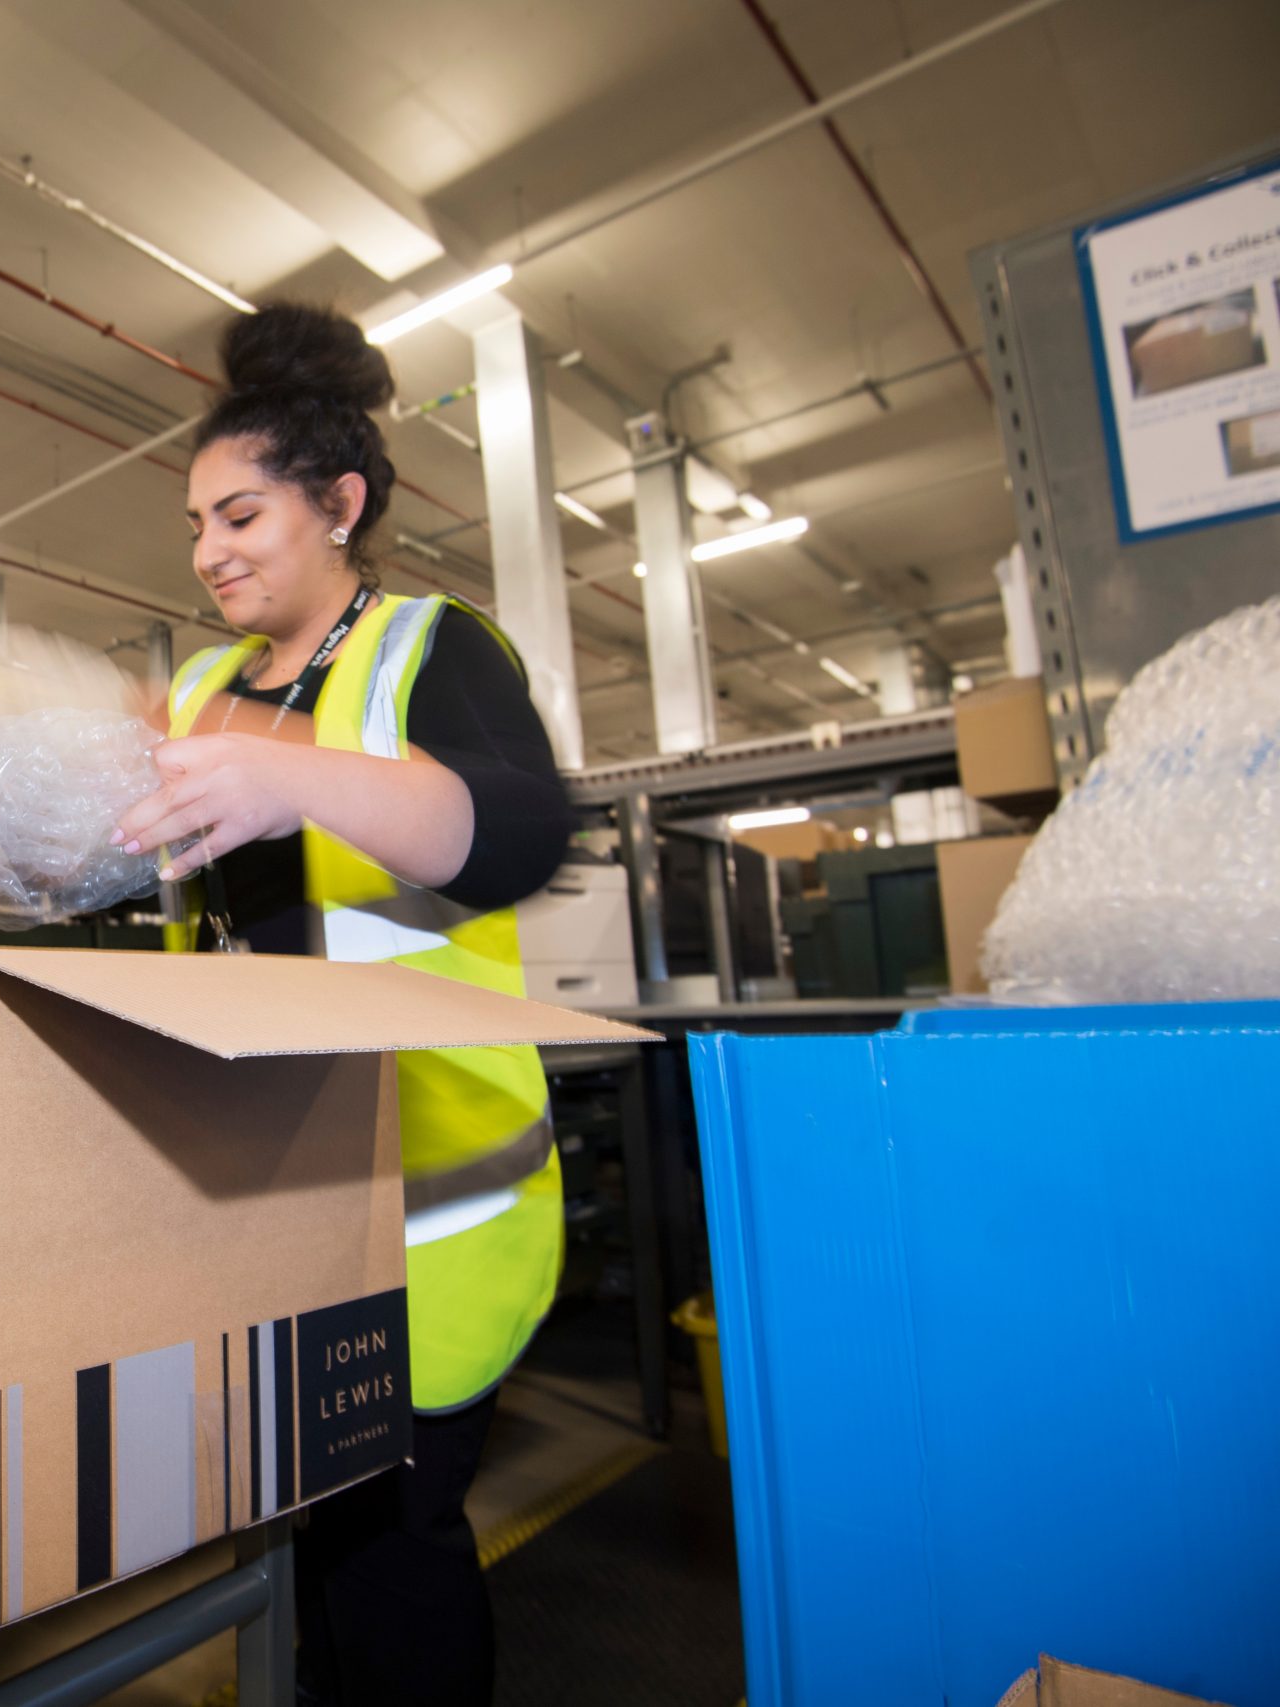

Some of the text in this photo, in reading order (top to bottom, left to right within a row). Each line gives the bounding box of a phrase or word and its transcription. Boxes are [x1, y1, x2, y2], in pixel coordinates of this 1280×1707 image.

[324, 623, 350, 650] Magna
[325, 1328, 387, 1371] JOHN
[320, 1373, 394, 1419] LEWIS
[338, 1423, 390, 1450] PARTNERS
